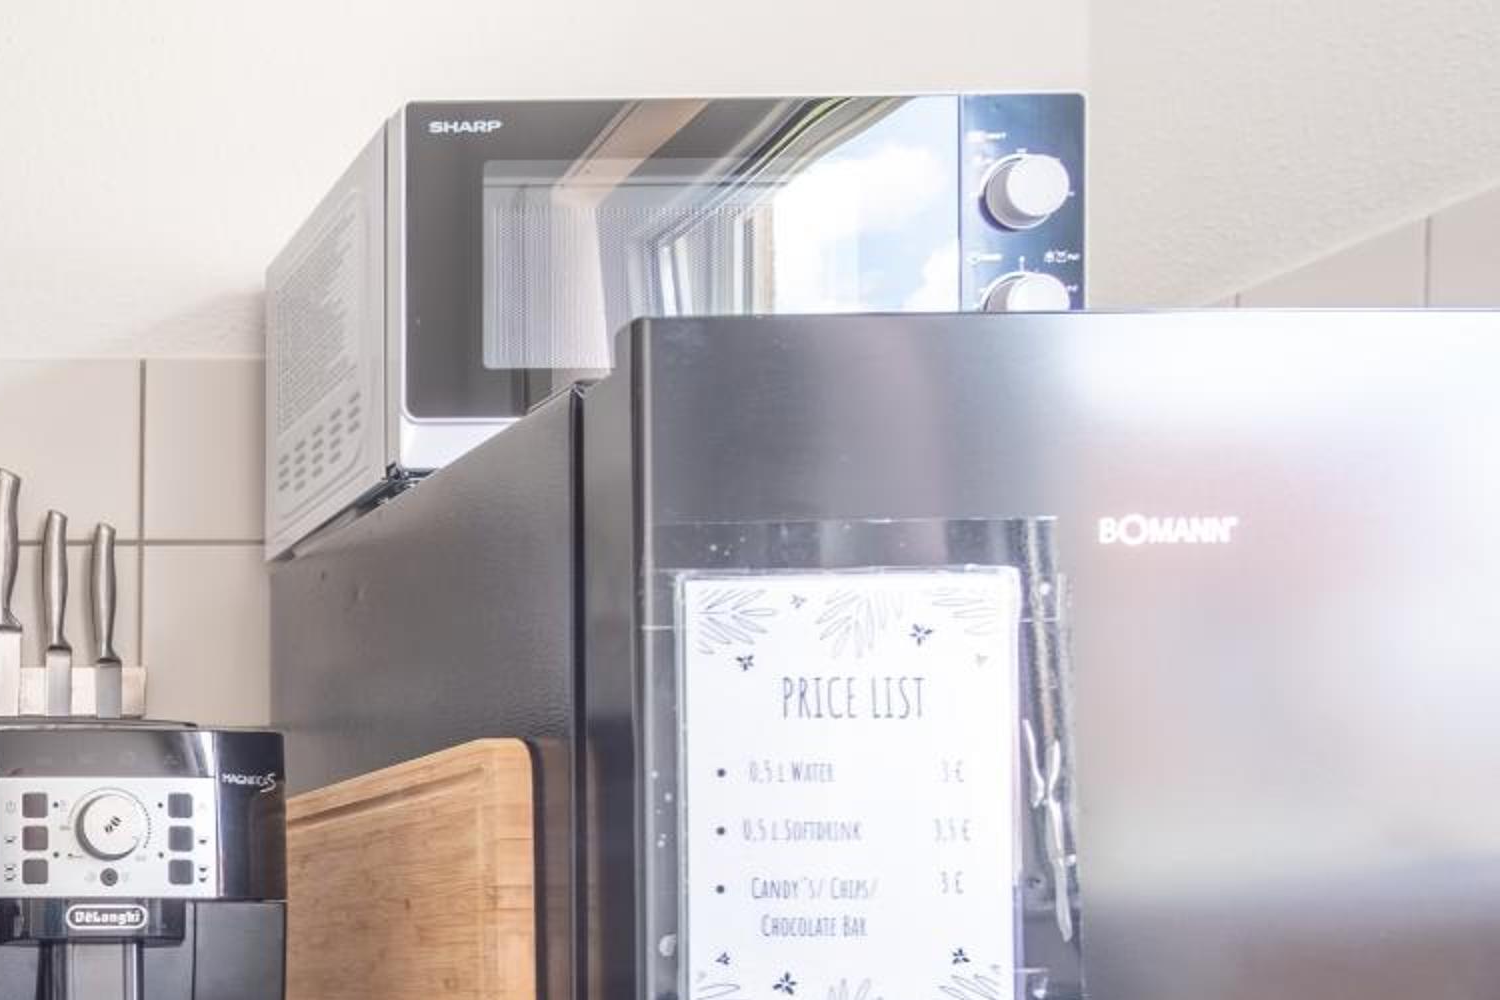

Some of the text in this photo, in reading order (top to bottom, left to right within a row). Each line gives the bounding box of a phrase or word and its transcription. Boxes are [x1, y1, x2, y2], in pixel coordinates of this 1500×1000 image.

[428, 120, 502, 133] SHARP
[1098, 513, 1233, 545] BOMANN
[782, 676, 925, 720] PRICE LIST
[962, 818, 973, 842] €
[955, 870, 965, 895] €
